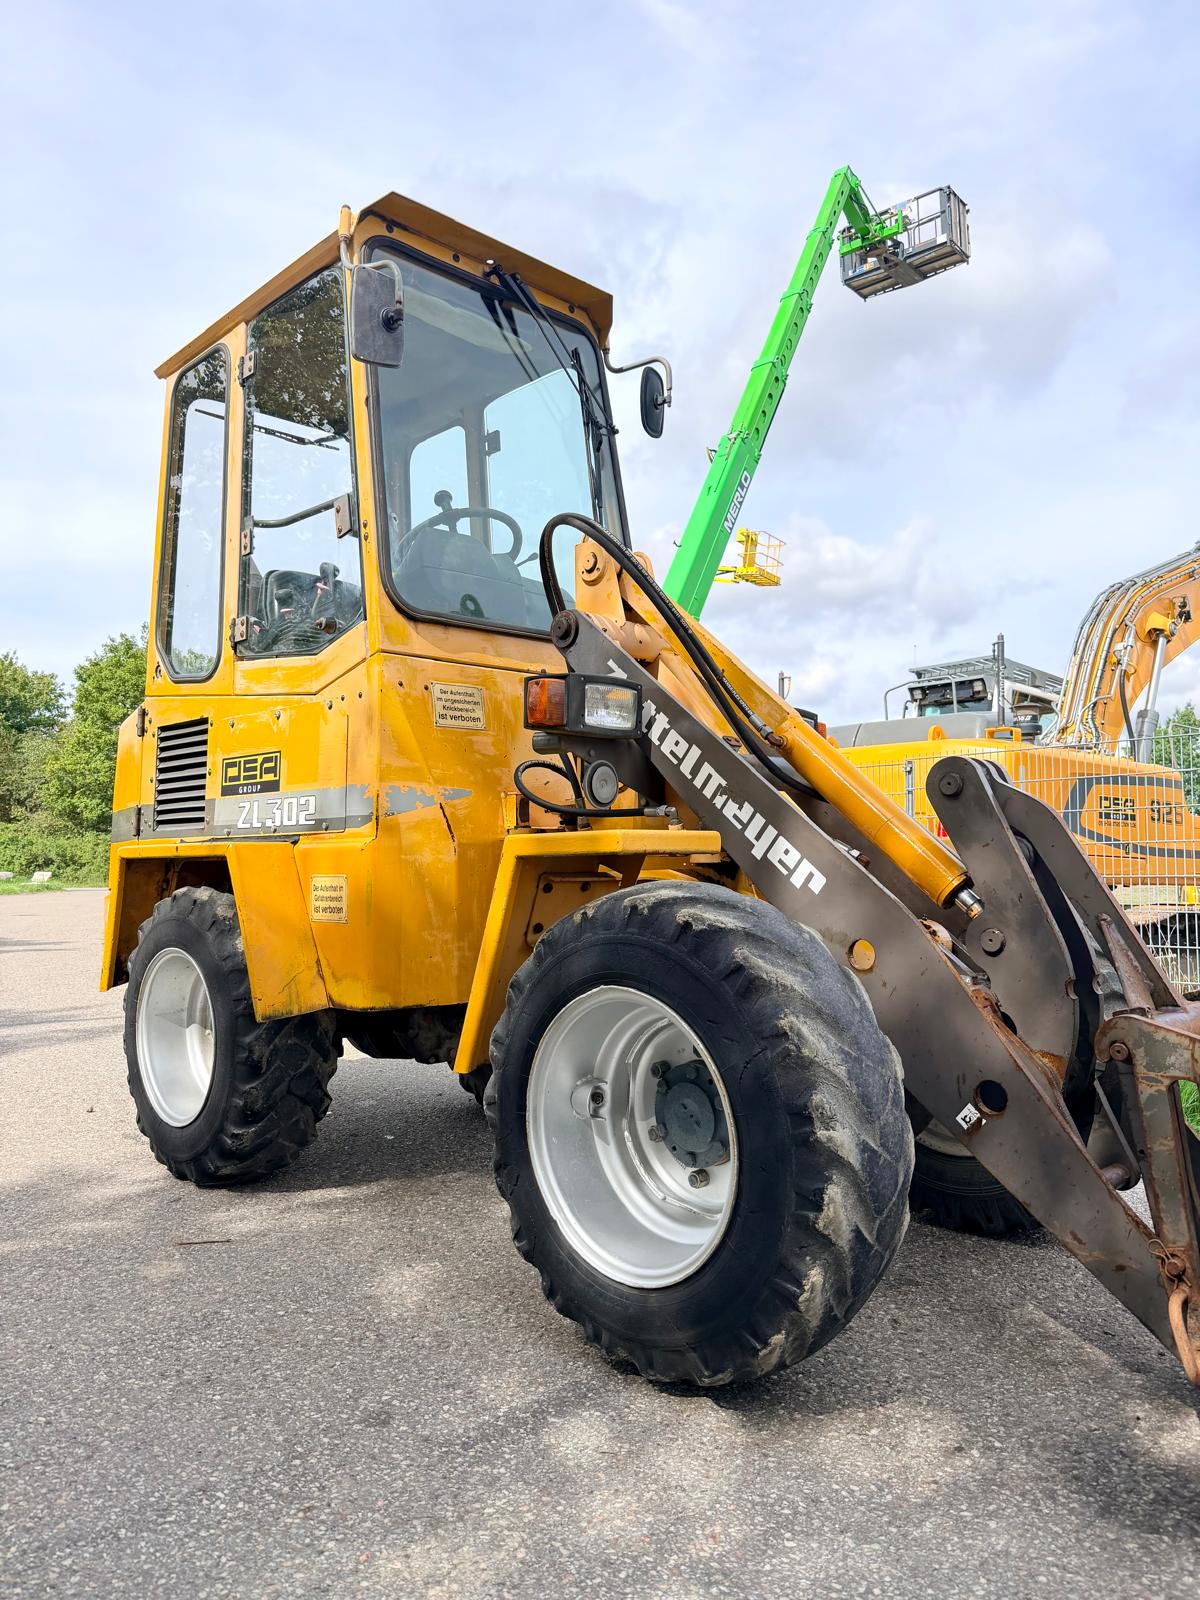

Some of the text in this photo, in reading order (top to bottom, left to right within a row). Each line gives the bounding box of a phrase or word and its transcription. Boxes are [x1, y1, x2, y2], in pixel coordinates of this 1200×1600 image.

[724, 470, 751, 534] MERLO
[438, 712, 482, 723] ist verboten
[607, 659, 827, 896] ttelmeyer
[238, 784, 261, 793] GROUP
[313, 904, 344, 914] ist verboten
